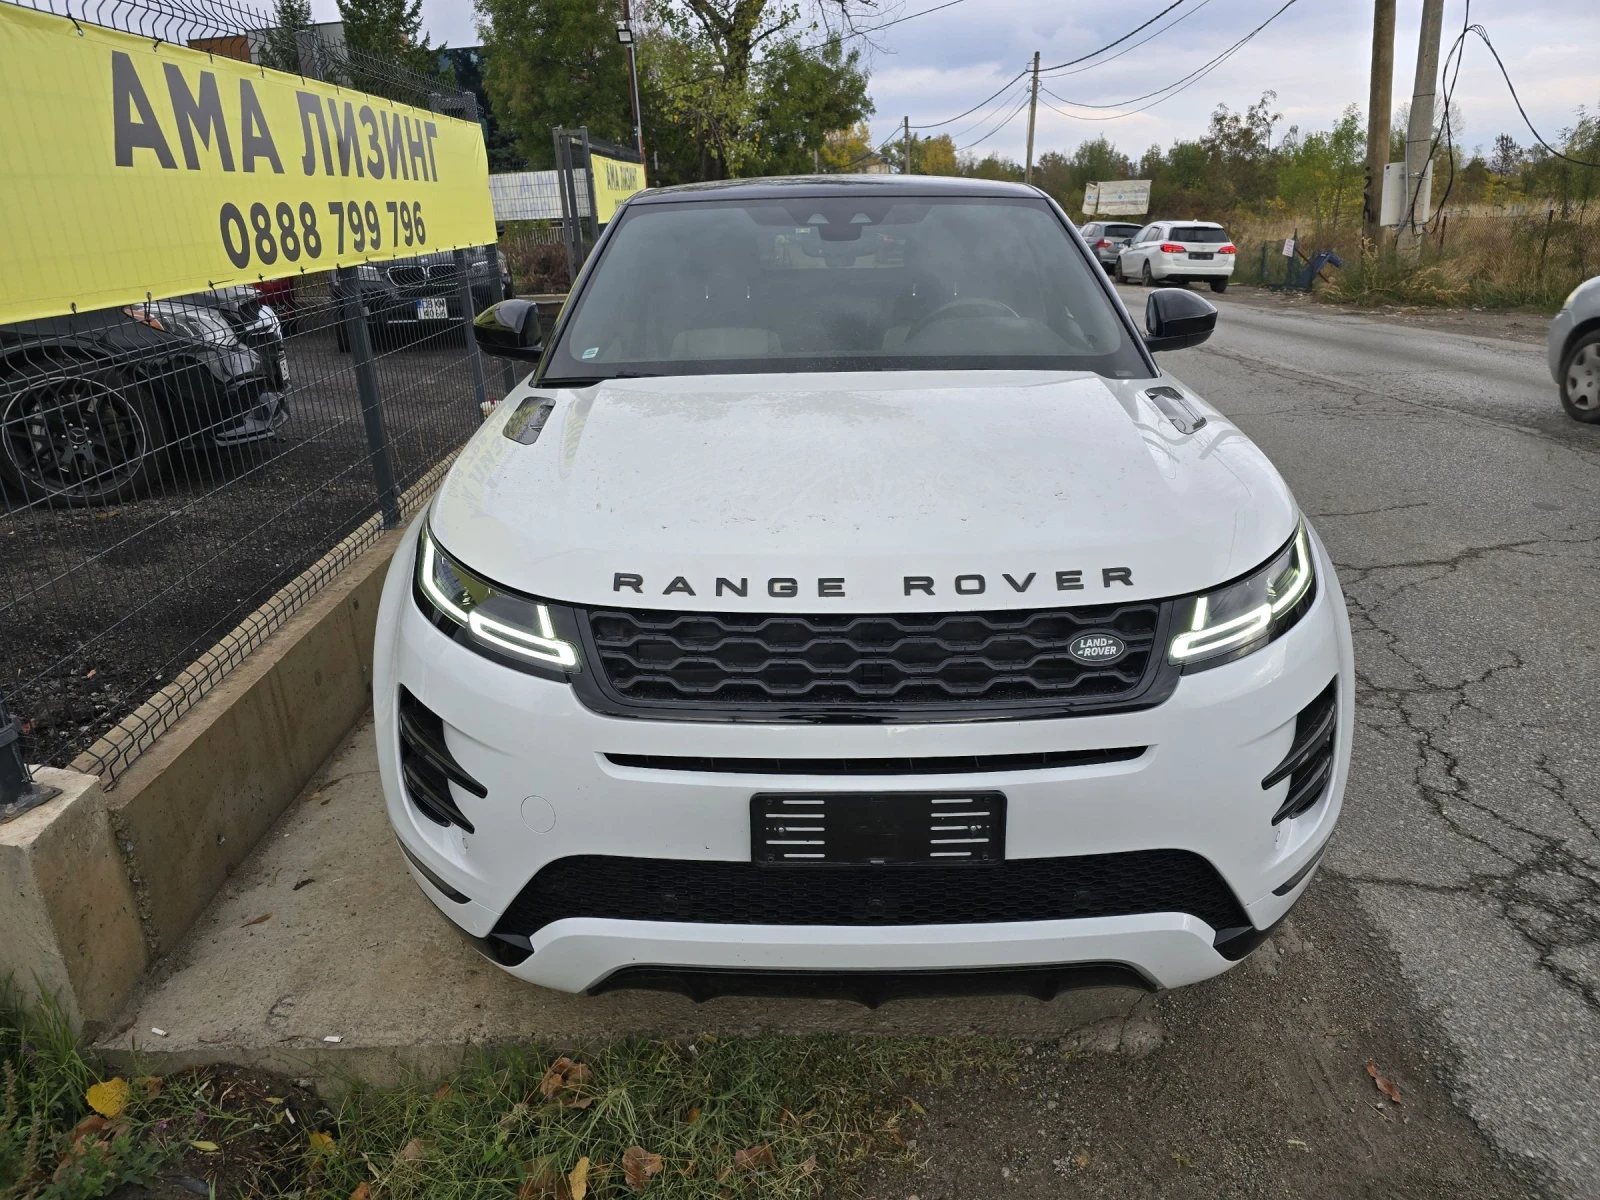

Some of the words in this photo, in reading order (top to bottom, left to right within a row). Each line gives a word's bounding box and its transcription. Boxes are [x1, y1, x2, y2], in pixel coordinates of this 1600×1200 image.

[112, 50, 284, 174] АМА
[295, 90, 438, 182] ЛИЗИНГ
[219, 201, 322, 269] 0888
[329, 200, 381, 254] 799
[386, 201, 426, 247] 796
[613, 572, 846, 598] RANGE
[903, 567, 1134, 596] ROVER
